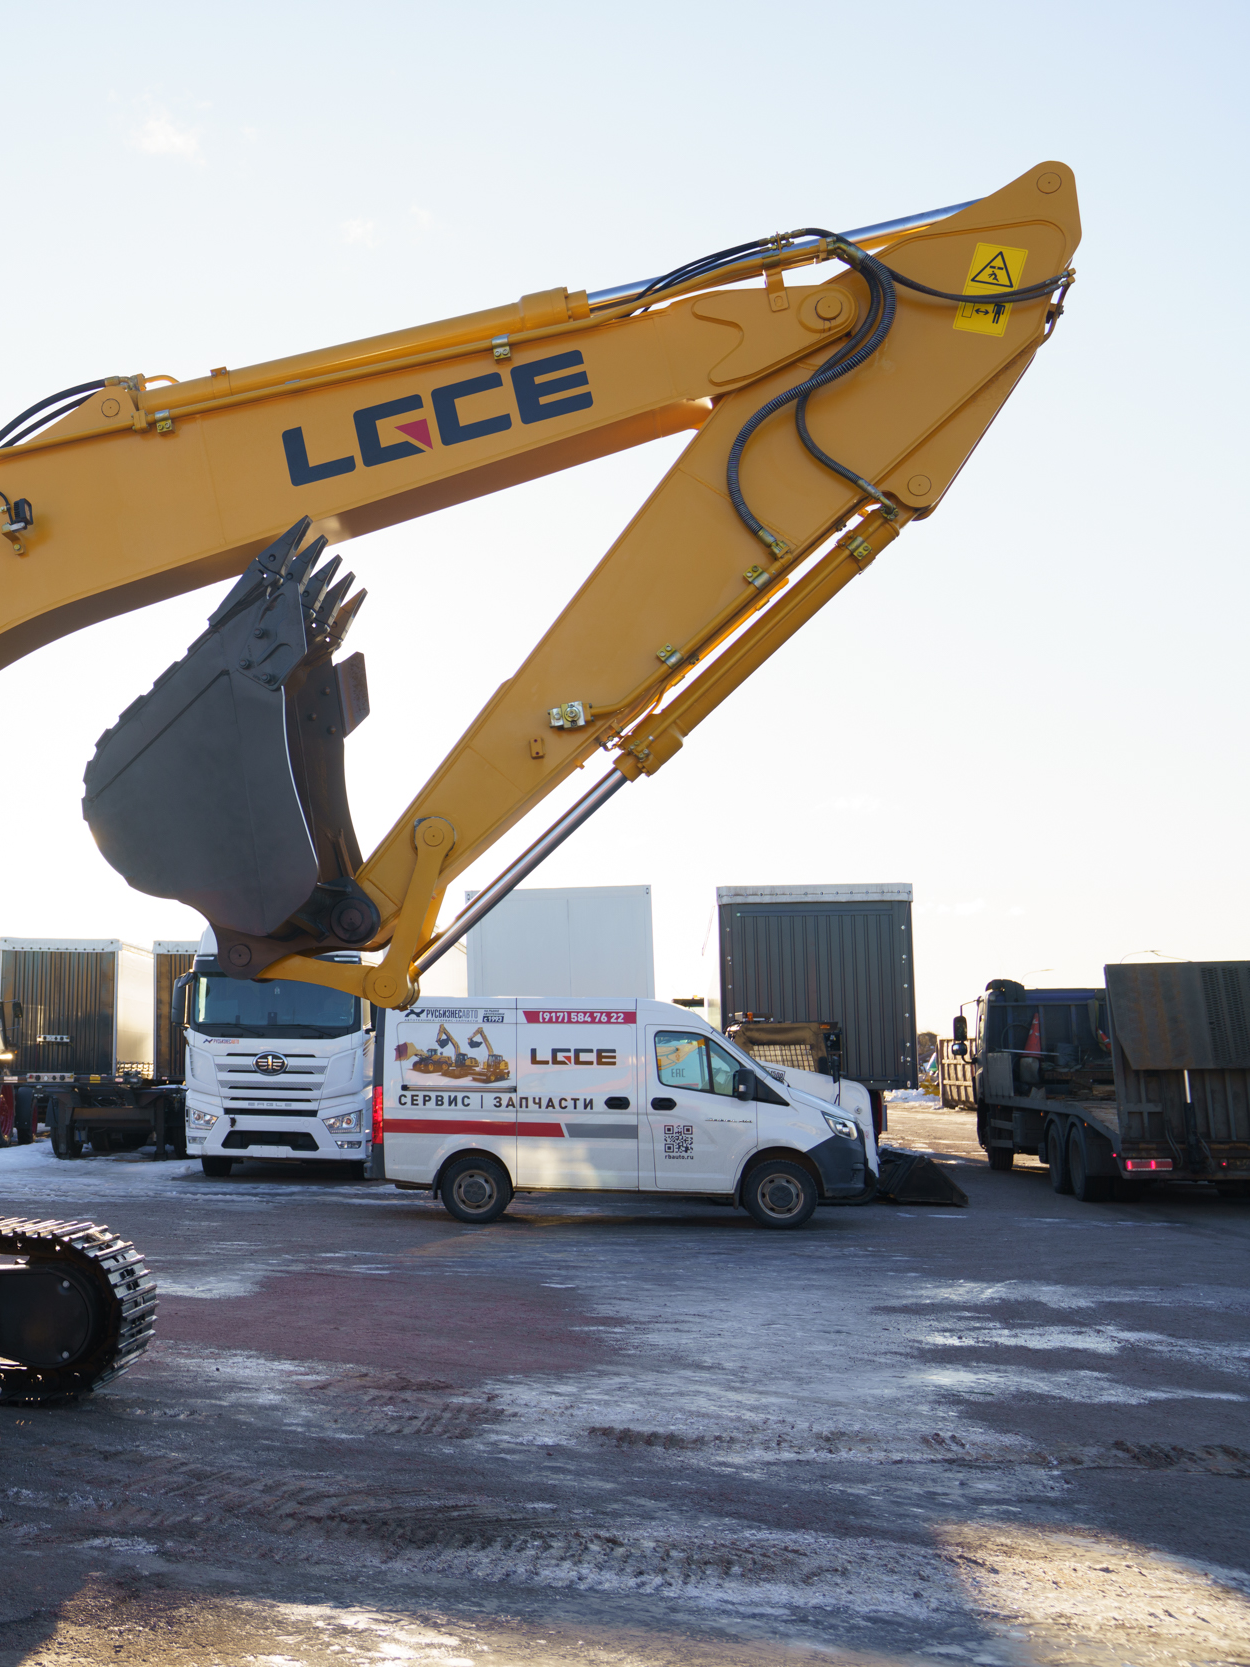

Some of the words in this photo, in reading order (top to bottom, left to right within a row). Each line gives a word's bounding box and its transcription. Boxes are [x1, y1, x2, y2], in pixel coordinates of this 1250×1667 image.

[282, 349, 594, 487] LGCE
[426, 1009, 478, 1018] РУСБИЗНЕСАВТО
[539, 1011, 568, 1022] (917)
[571, 1012, 591, 1022] 584
[594, 1013, 608, 1022] 76
[610, 1013, 625, 1022] 22
[530, 1048, 616, 1066] LGCE
[398, 1094, 471, 1107] СЕРВИС
[493, 1096, 594, 1110] ЗАПЧАСТИ
